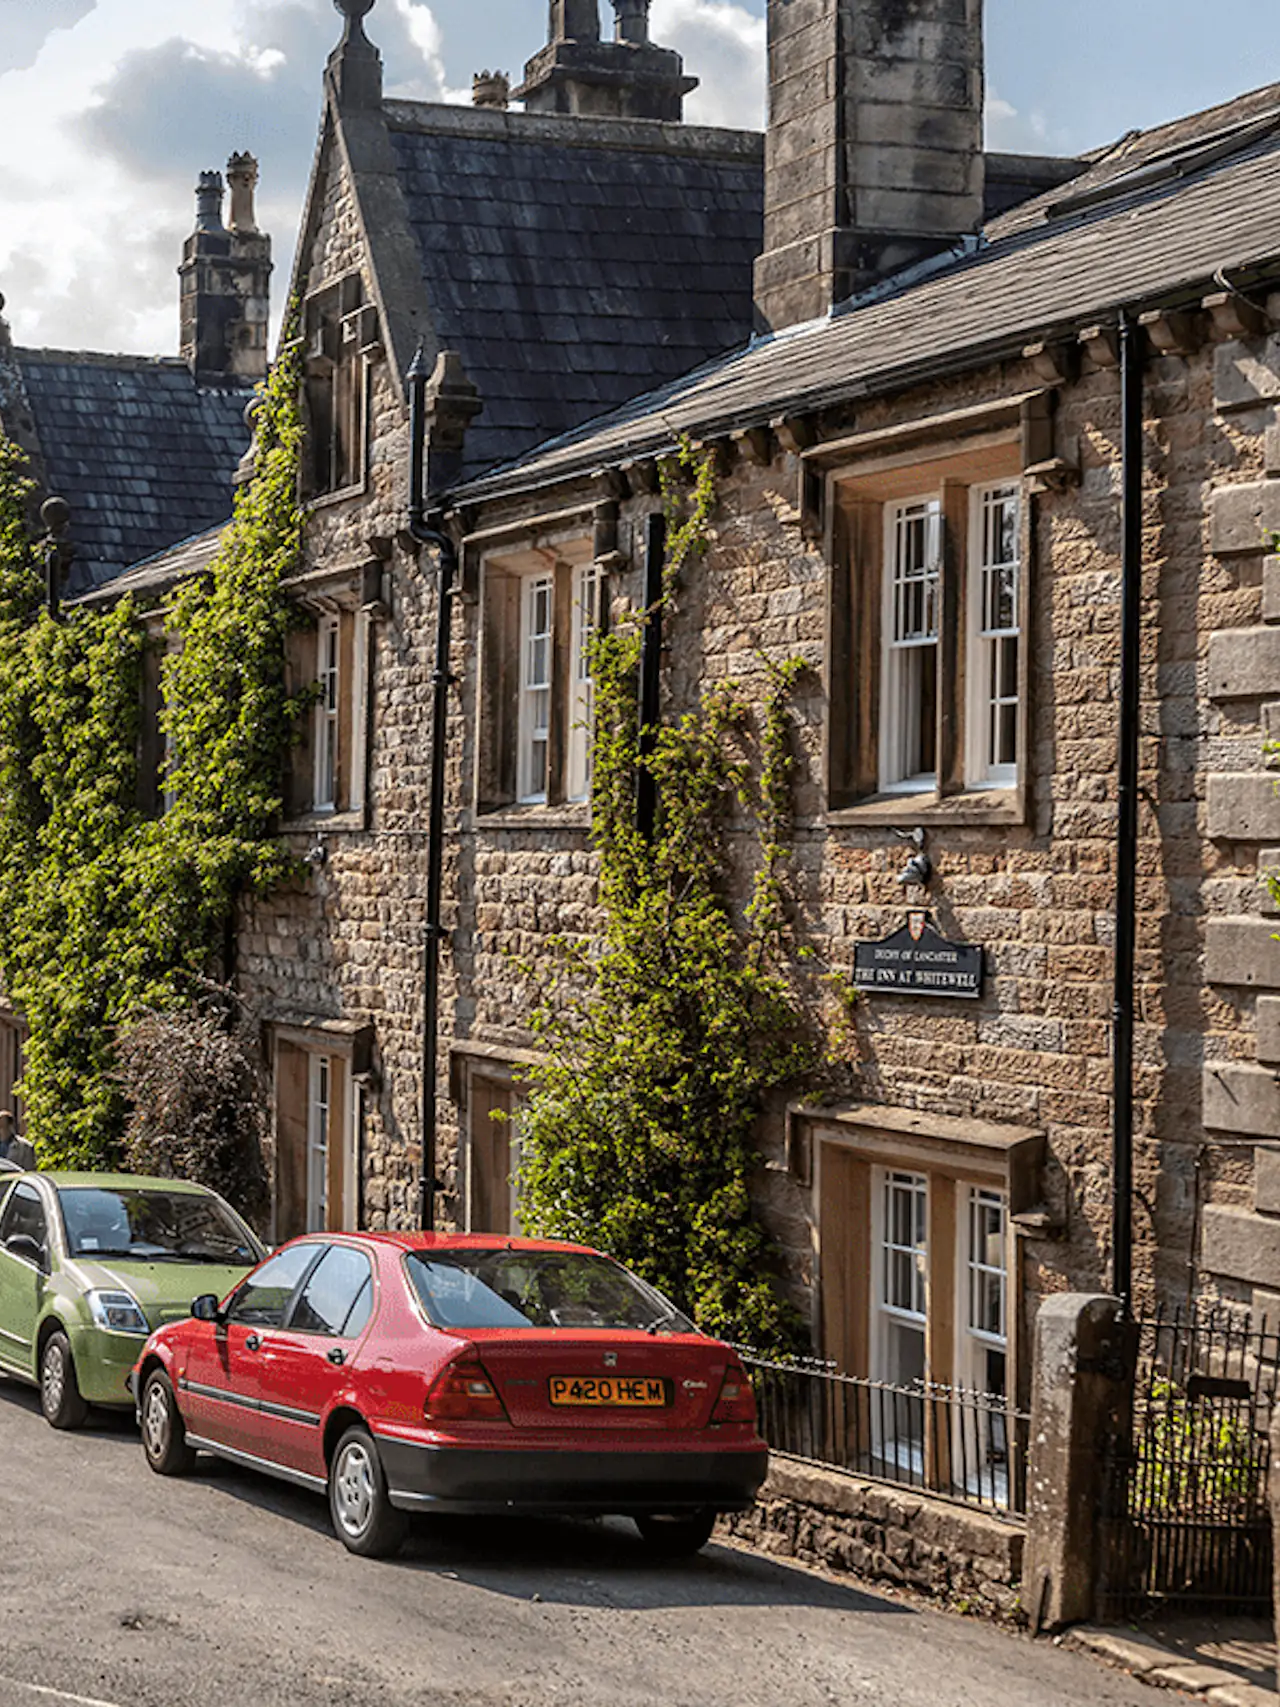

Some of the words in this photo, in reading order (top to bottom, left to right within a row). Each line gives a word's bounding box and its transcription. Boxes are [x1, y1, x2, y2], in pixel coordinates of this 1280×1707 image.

[874, 948, 899, 960] DUCHY
[901, 949, 911, 961] OF
[914, 950, 958, 963] LANCASTER
[855, 968, 874, 981] THE
[877, 968, 895, 982] INN
[899, 971, 912, 983] AT
[915, 971, 977, 987] WHITEWELL
[554, 1379, 612, 1401] P420
[618, 1381, 662, 1401] HEM
